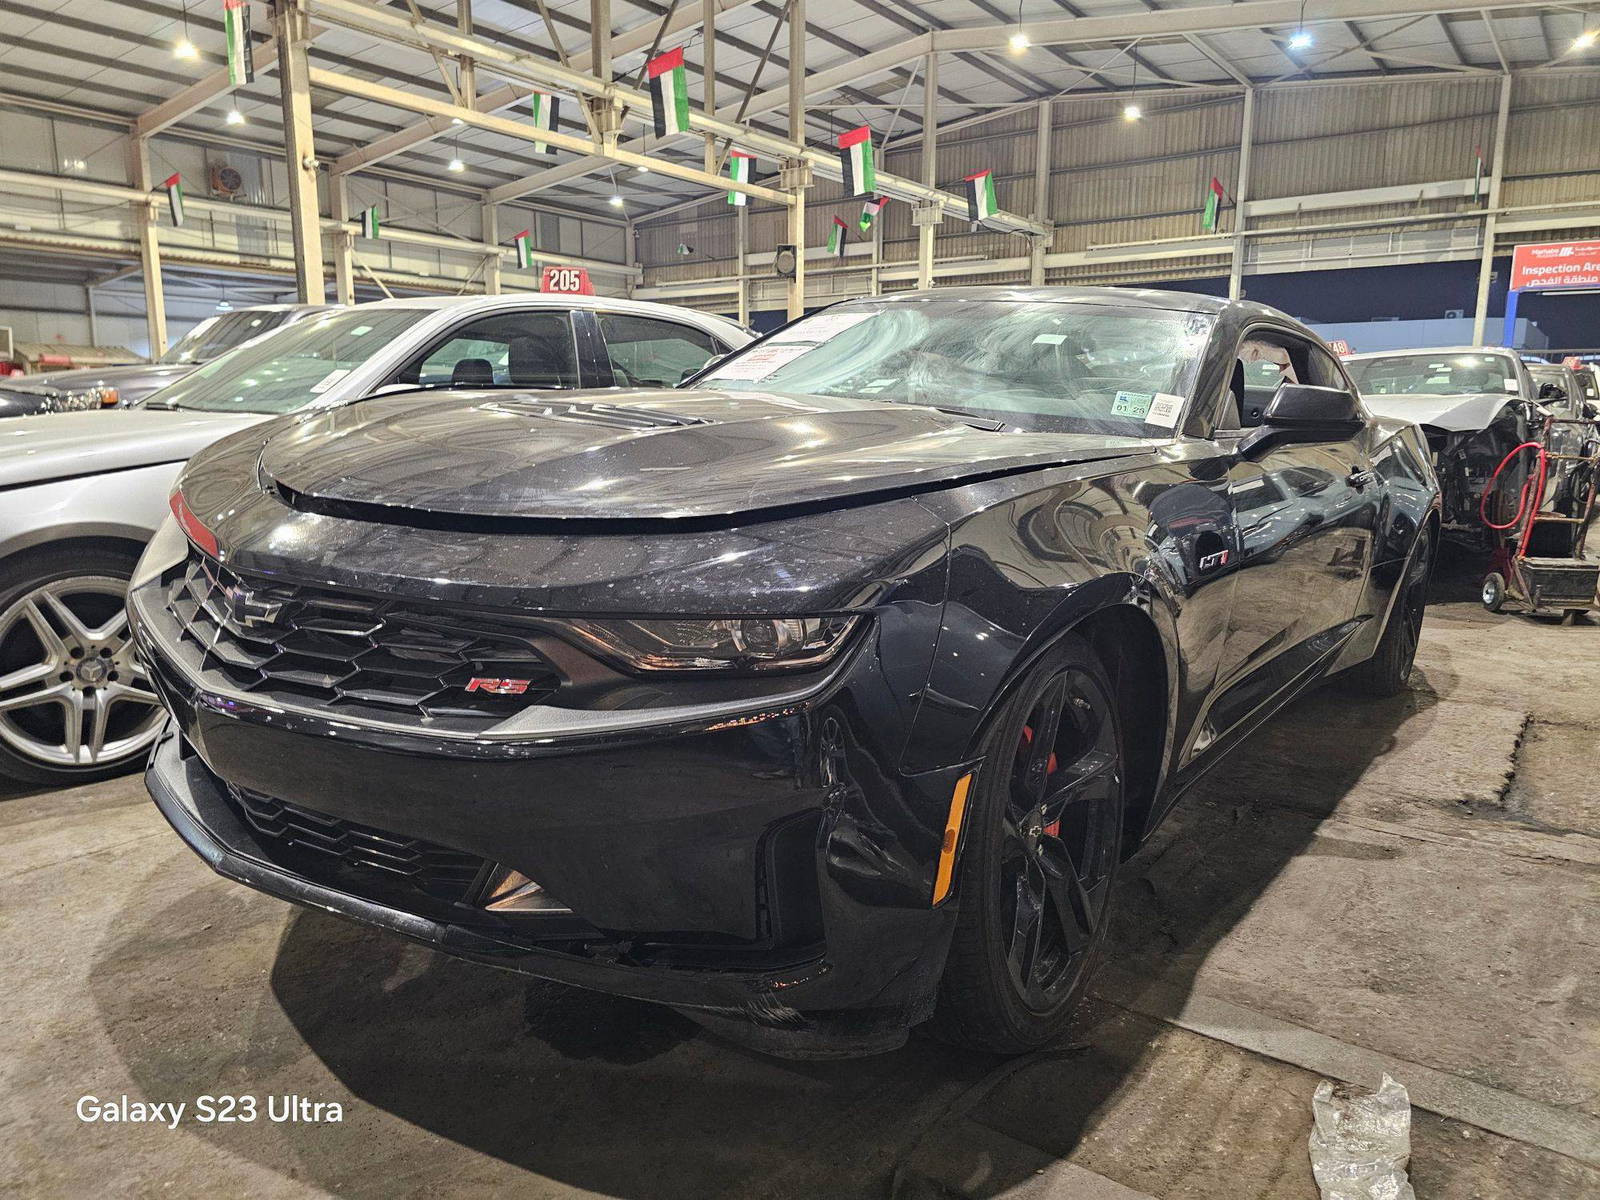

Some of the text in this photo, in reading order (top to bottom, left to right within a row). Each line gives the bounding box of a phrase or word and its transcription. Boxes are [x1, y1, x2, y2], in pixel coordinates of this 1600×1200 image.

[1522, 264, 1581, 276] Inspection
[549, 269, 580, 291] 205
[464, 677, 532, 694] RS
